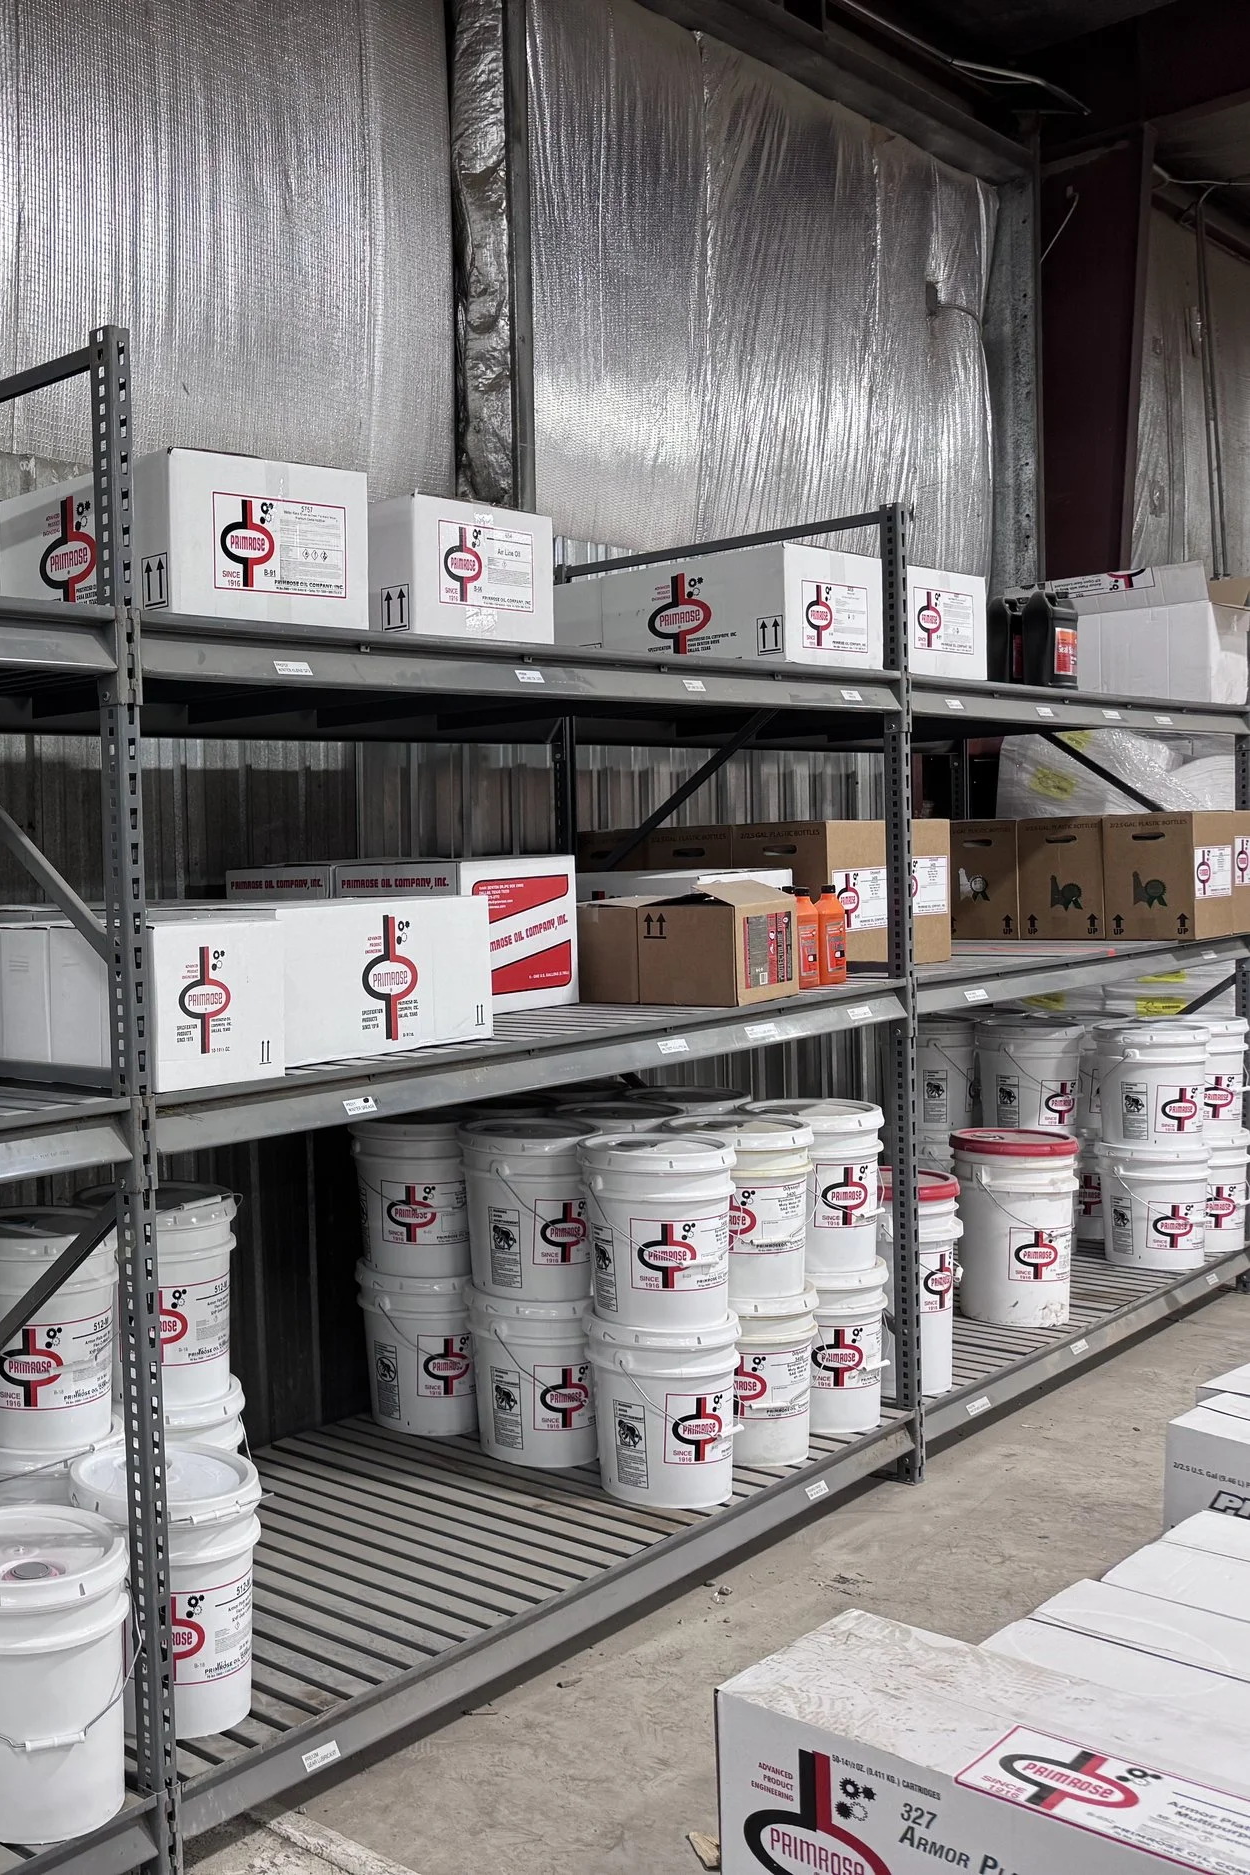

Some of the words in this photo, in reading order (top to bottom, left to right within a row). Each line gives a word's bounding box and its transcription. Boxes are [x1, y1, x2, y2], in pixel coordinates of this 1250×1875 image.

[230, 534, 265, 552] PRIMROSE
[50, 547, 88, 573] PRIMROSE
[450, 557, 476, 572] PRIMROSE
[222, 570, 240, 579] SINCE
[660, 609, 700, 627] PRIMROSE
[231, 880, 263, 890] PRIMROSE
[265, 880, 275, 889] OIL
[276, 879, 309, 890] COMPANY,
[310, 878, 323, 887] INC.
[342, 879, 378, 889] PRIMROSE
[381, 879, 392, 888] OIL
[395, 877, 433, 890] COMPANY,
[435, 877, 449, 886] INC.
[373, 970, 407, 987] PRIMROSE
[188, 993, 222, 1006] PRIMROSE
[1169, 1105, 1193, 1114] PRIMROSE
[831, 1190, 862, 1202] PRIMROSE
[395, 1207, 428, 1219] PRIMROSE
[550, 1227, 581, 1237] PRIMROSE
[648, 1250, 687, 1262] PRIMROSE
[1023, 1250, 1052, 1260] PRIMROSE
[822, 1351, 856, 1363] PRIMROSE
[8, 1361, 52, 1374] PRIMROSE
[0, 1391, 21, 1400] SINCE
[550, 1391, 582, 1404] PRIMROSE
[682, 1422, 716, 1435] PRIMROSE
[758, 1762, 793, 1780] ADVANCED
[763, 1774, 794, 1791] PRODUCT
[980, 1775, 1028, 1794] SINCE
[1022, 1762, 1114, 1798] PRIMROSE
[751, 1781, 794, 1802] ENGINEERING
[989, 1784, 1020, 1798] 1916
[901, 1803, 938, 1830] 327
[770, 1827, 864, 1875] PRIMROSE
[899, 1826, 970, 1868] ARMOR
[1112, 1825, 1186, 1852] PRIMROSE
[1187, 1851, 1211, 1865] OIL
